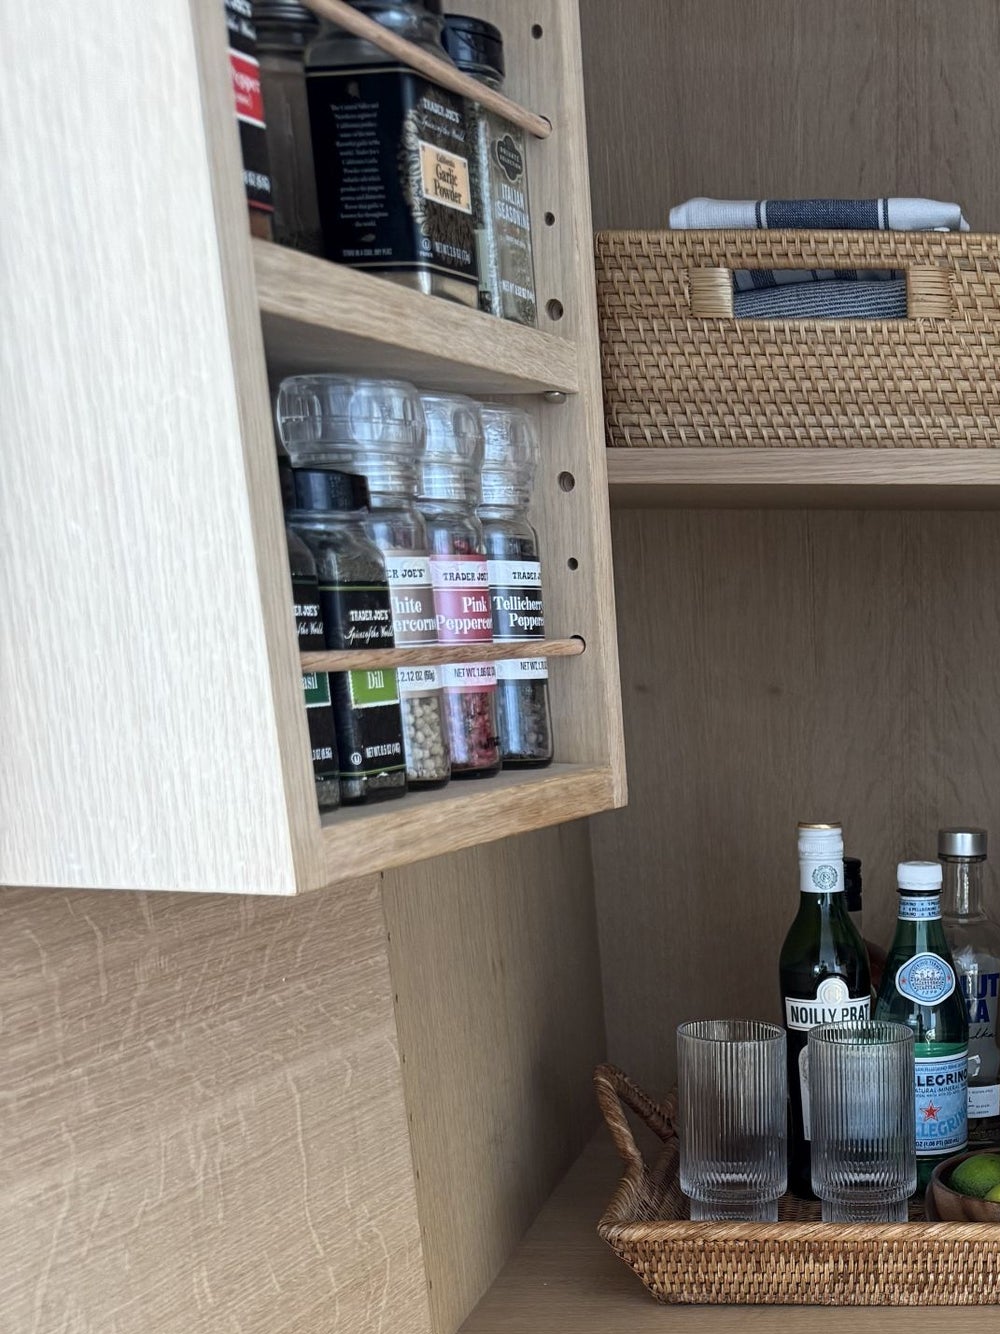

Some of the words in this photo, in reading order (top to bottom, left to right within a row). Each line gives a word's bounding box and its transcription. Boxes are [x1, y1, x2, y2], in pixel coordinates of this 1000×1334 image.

[435, 163, 458, 187] Garlic
[433, 178, 462, 204] Powder
[501, 183, 524, 208] ITALIAN
[401, 568, 425, 578] JOE'S
[444, 572, 476, 582] TRADER
[477, 572, 488, 581] JOE
[512, 571, 537, 580] TRADER
[394, 596, 422, 614] hite
[463, 597, 488, 614] Pink
[349, 609, 373, 622] TRADER
[373, 609, 390, 621] JOE'S
[394, 617, 436, 632] ercorn
[454, 668, 465, 678] NET
[520, 661, 530, 671] NET
[302, 672, 319, 690] asil
[367, 671, 385, 690] Dill
[400, 671, 415, 682] 2.12
[415, 671, 423, 681] OZ
[791, 1005, 837, 1024] NOILLY
[842, 1003, 869, 1021] PRAT
[917, 1069, 968, 1087] LEGRINO
[920, 1106, 968, 1138] LEGRIN
